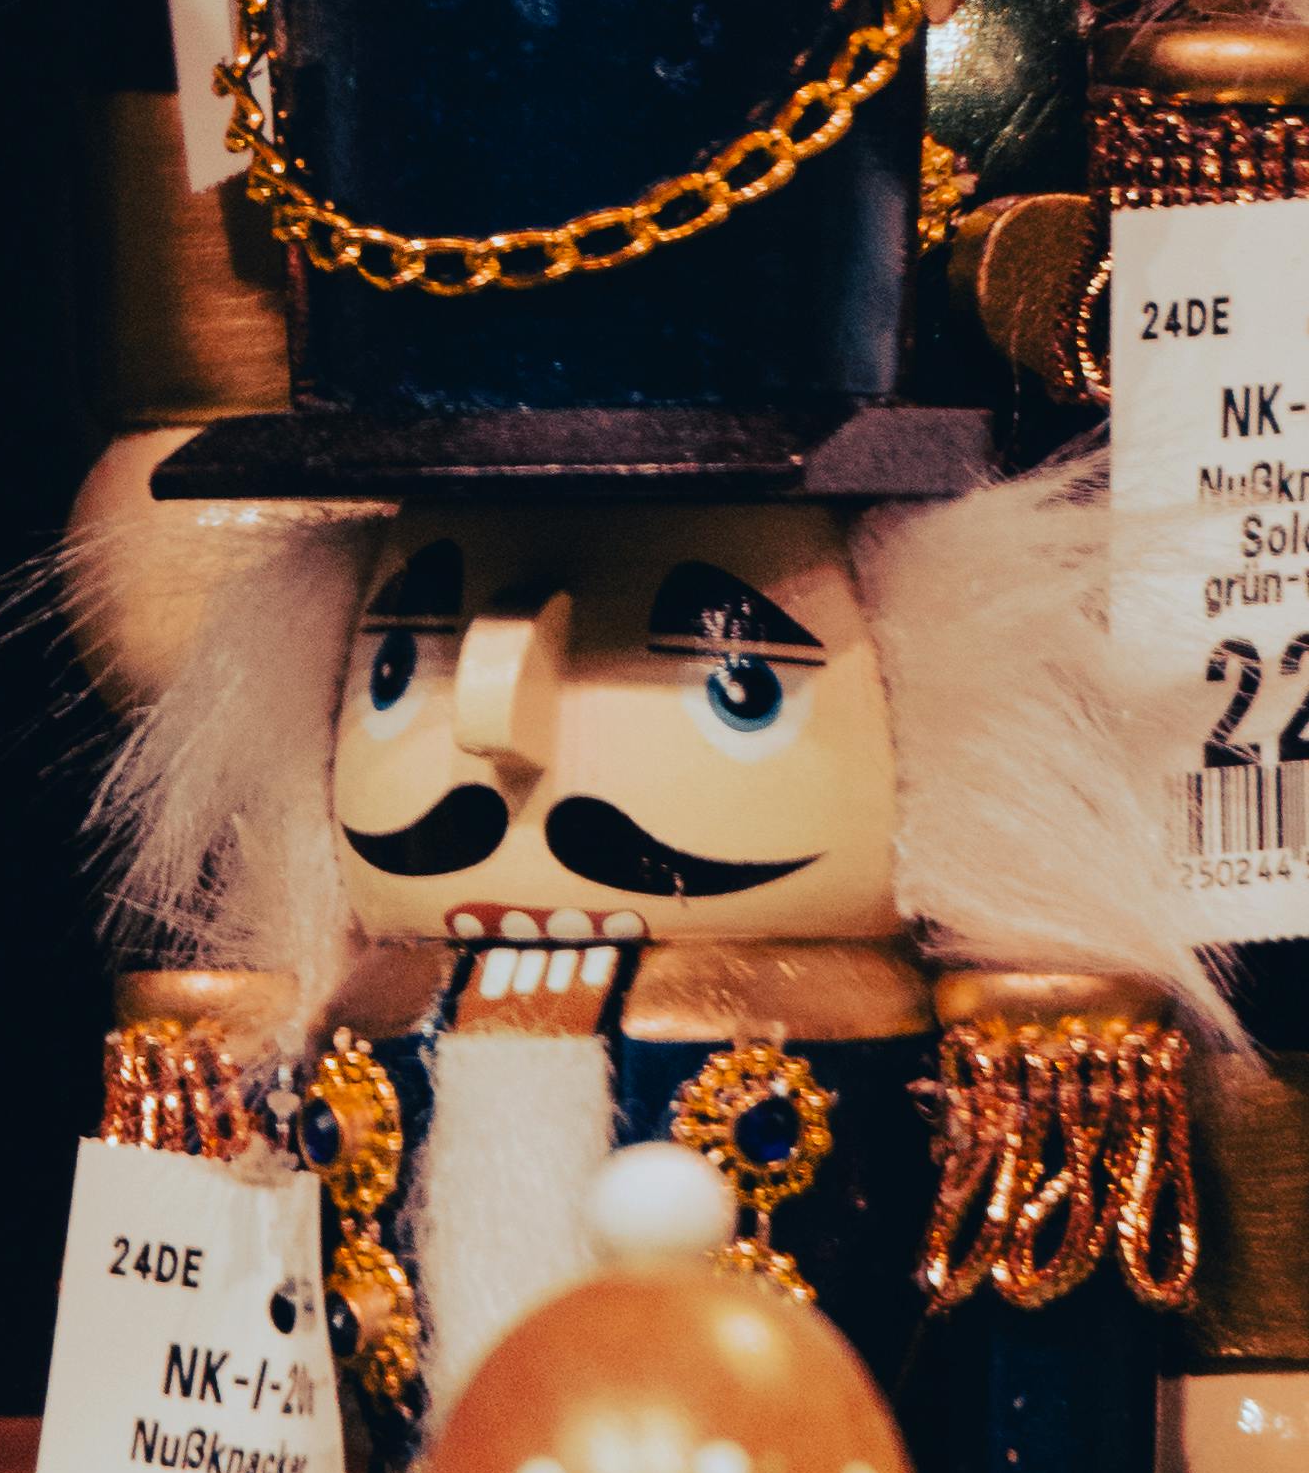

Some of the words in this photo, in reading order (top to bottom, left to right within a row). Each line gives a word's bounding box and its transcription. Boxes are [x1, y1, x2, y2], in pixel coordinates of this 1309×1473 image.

[1141, 296, 1230, 341] 24DE
[1242, 511, 1309, 558] Sol
[1205, 561, 1309, 619] grün-
[110, 1235, 203, 1288] 24DE
